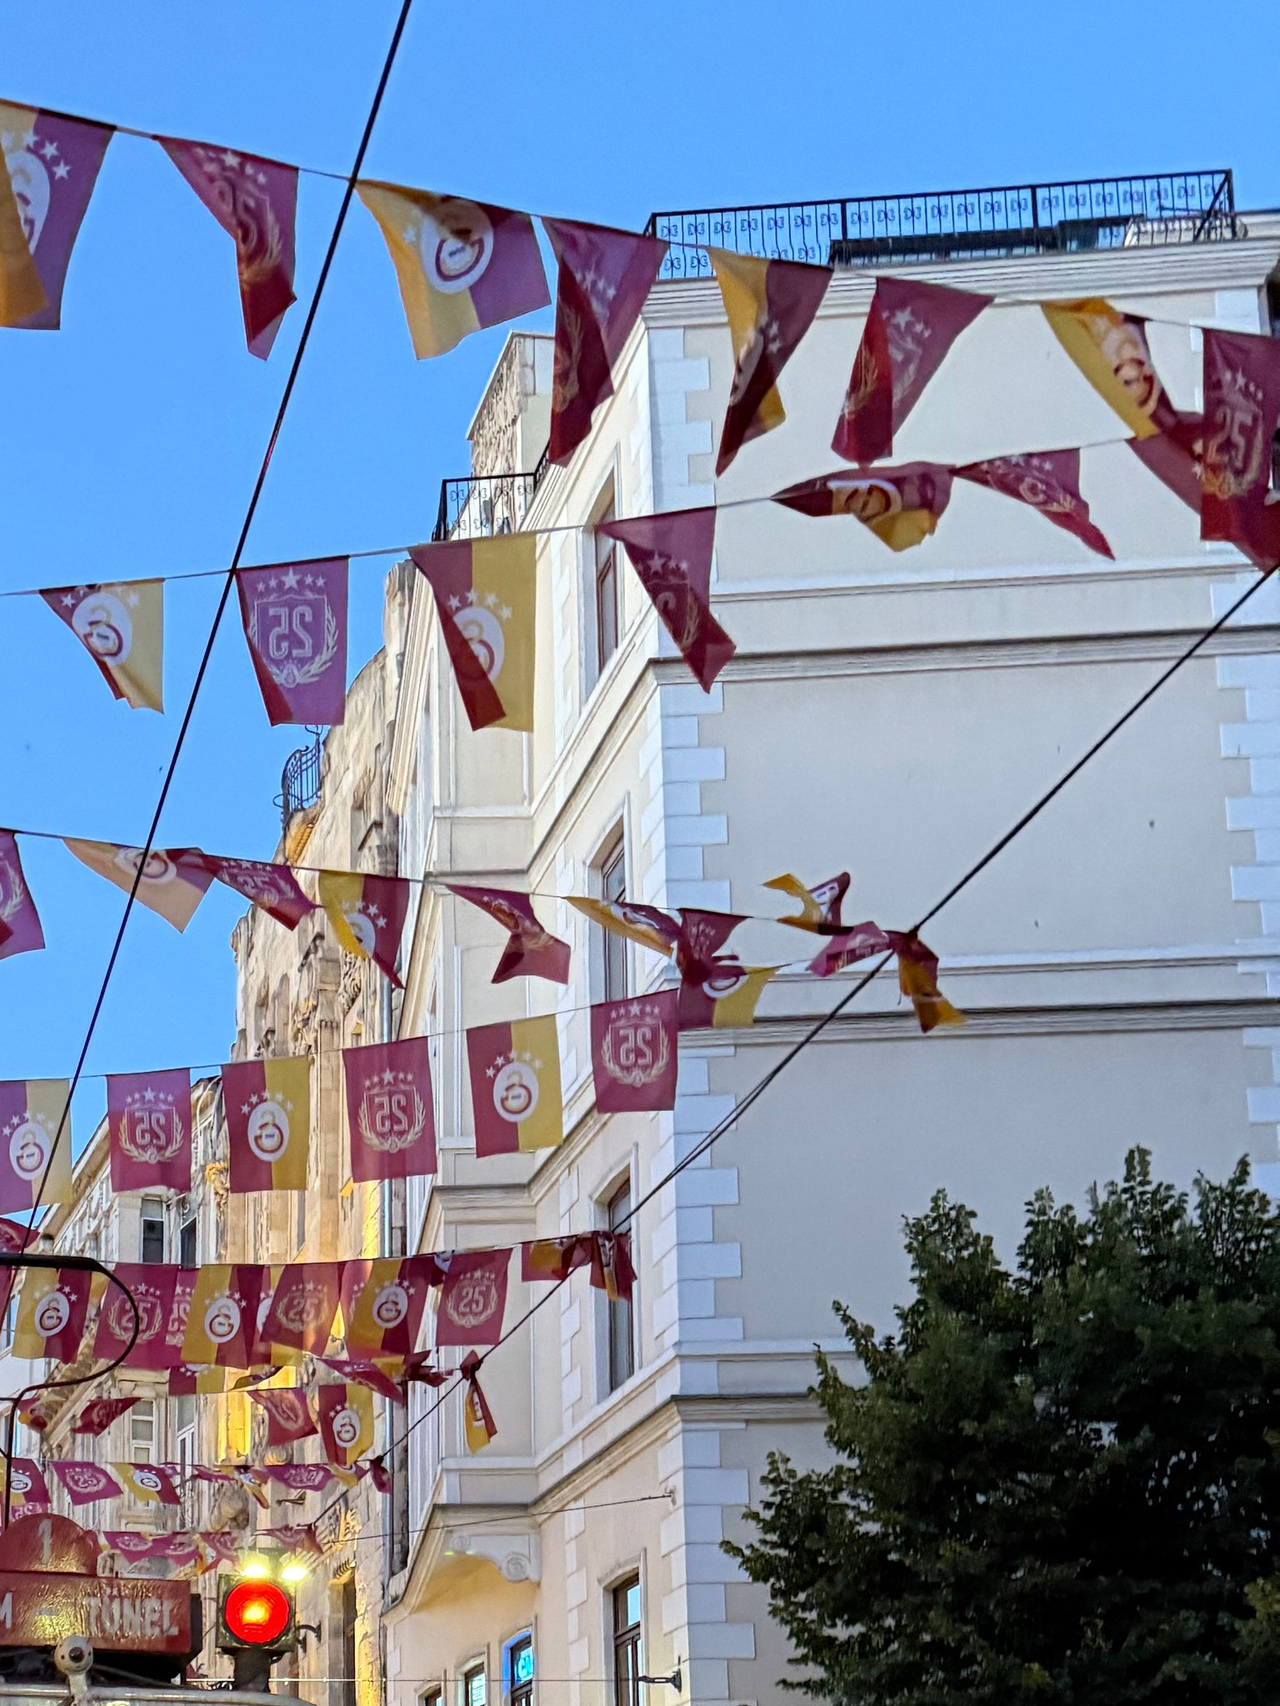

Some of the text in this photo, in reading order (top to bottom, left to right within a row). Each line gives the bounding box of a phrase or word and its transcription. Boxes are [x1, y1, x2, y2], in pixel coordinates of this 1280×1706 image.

[462, 1286, 484, 1313] 25
[36, 1518, 53, 1566] 1
[83, 1586, 180, 1636] TÜNEL
